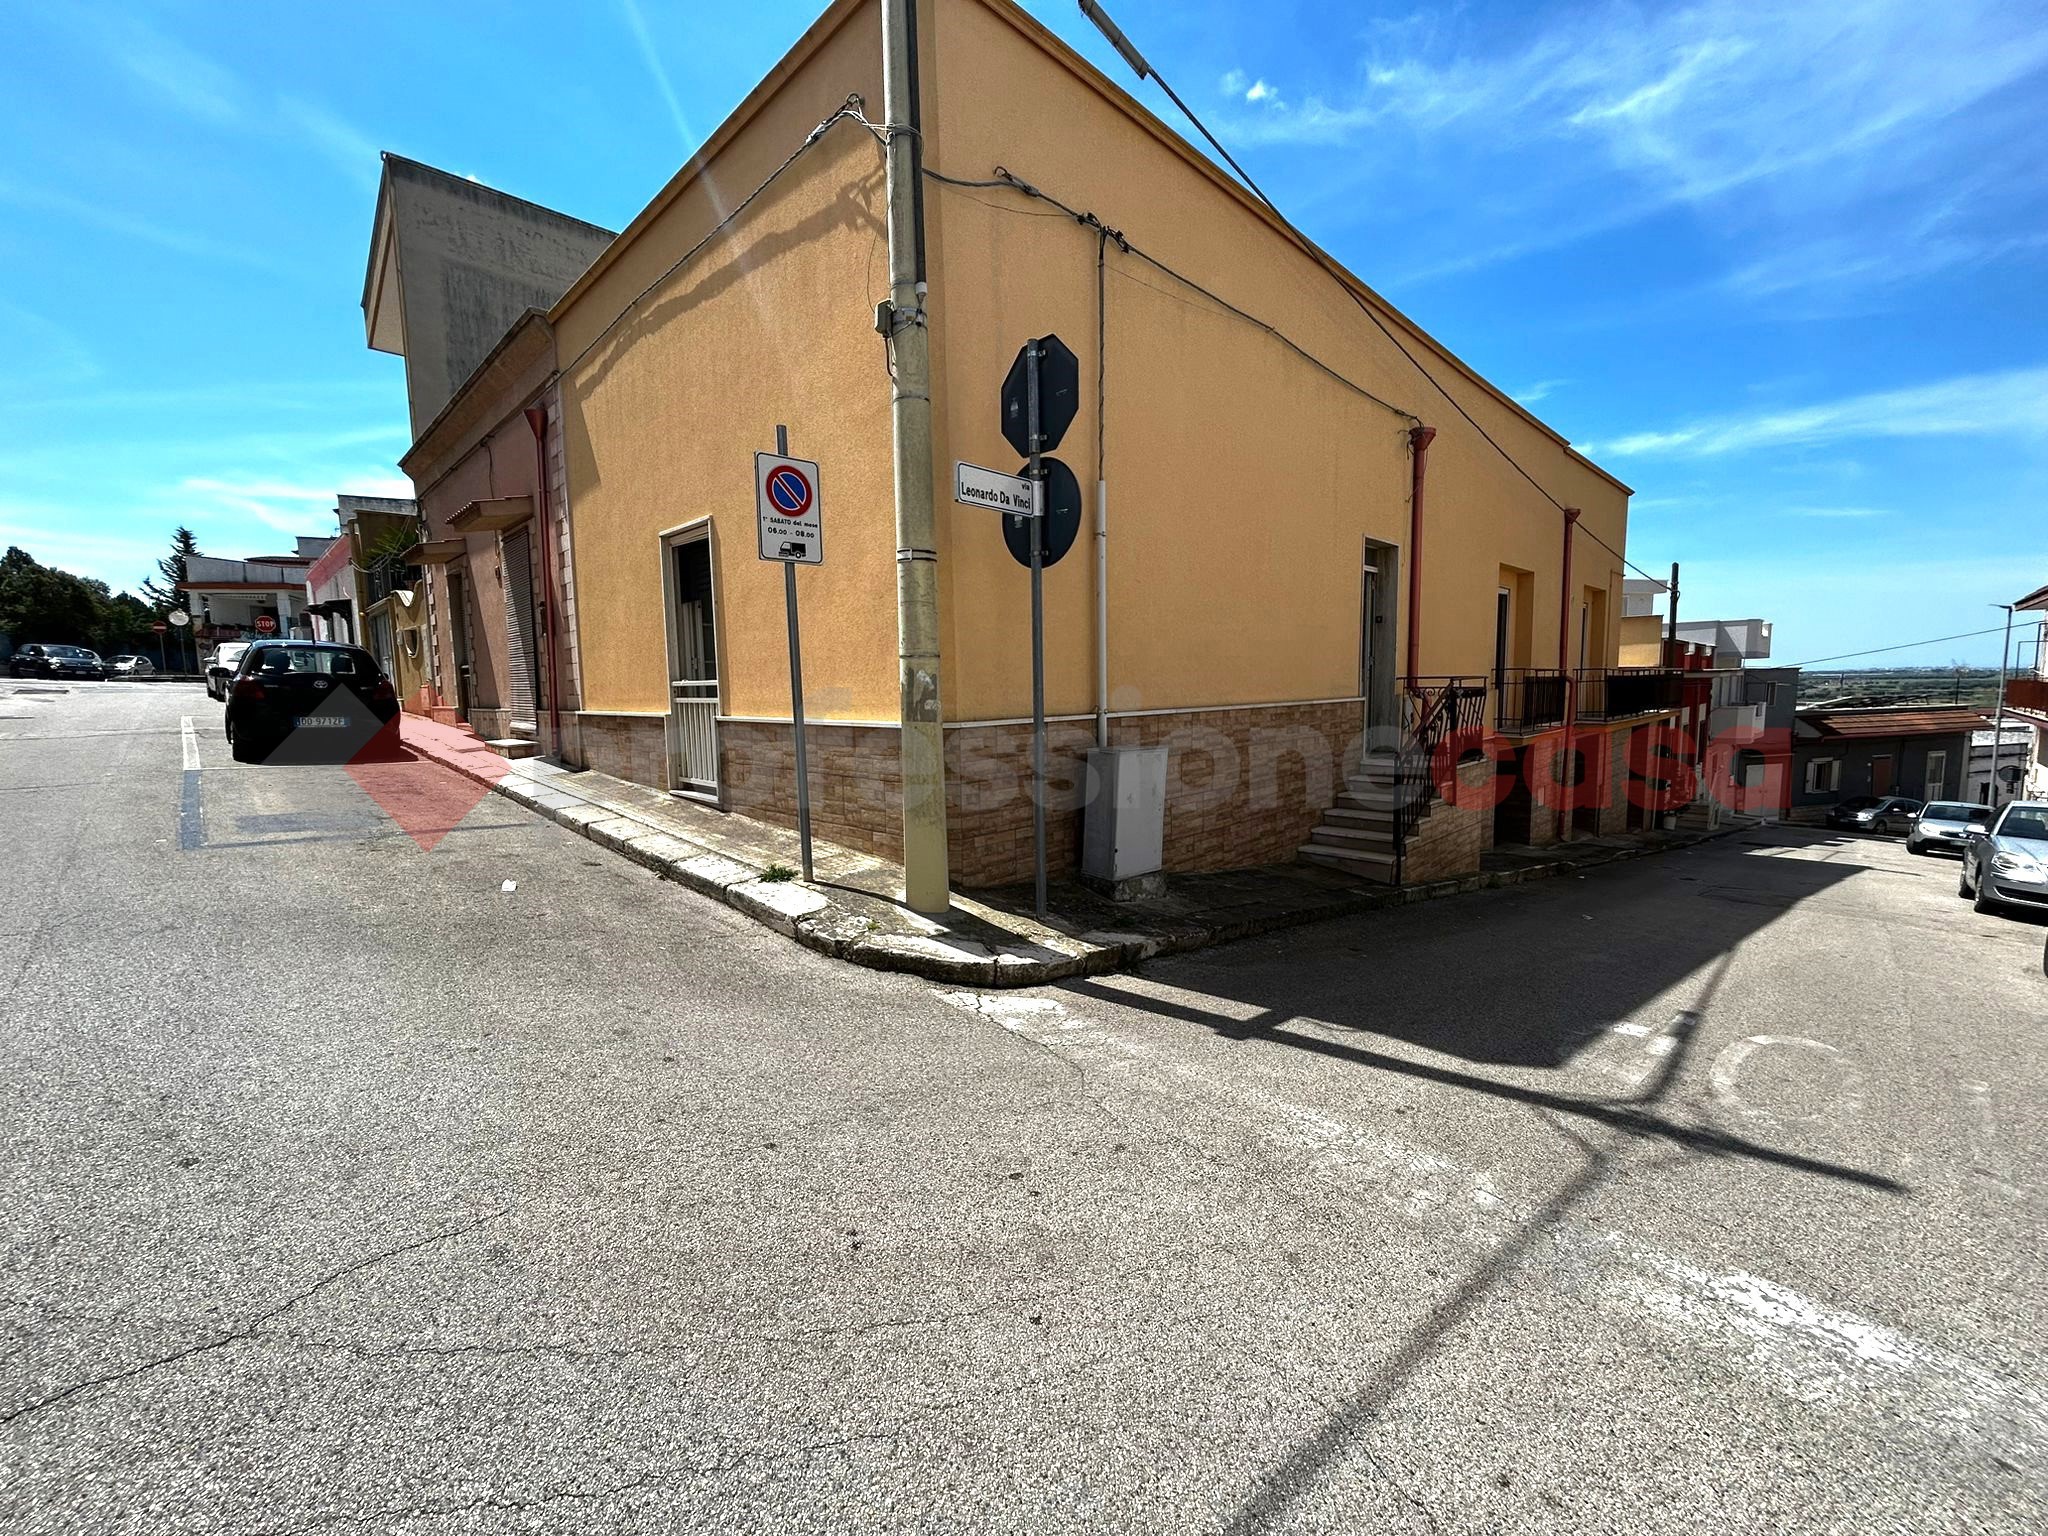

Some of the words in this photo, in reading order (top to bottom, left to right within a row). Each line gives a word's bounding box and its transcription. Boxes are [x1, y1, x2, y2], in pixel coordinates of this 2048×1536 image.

[1021, 483, 1030, 491] via
[961, 482, 998, 502] Leonardo
[1000, 491, 1010, 505] Da
[1012, 493, 1031, 510] Vinci
[770, 517, 791, 525] SABATO
[768, 527, 787, 535] 06.00
[795, 530, 815, 538] 08.00
